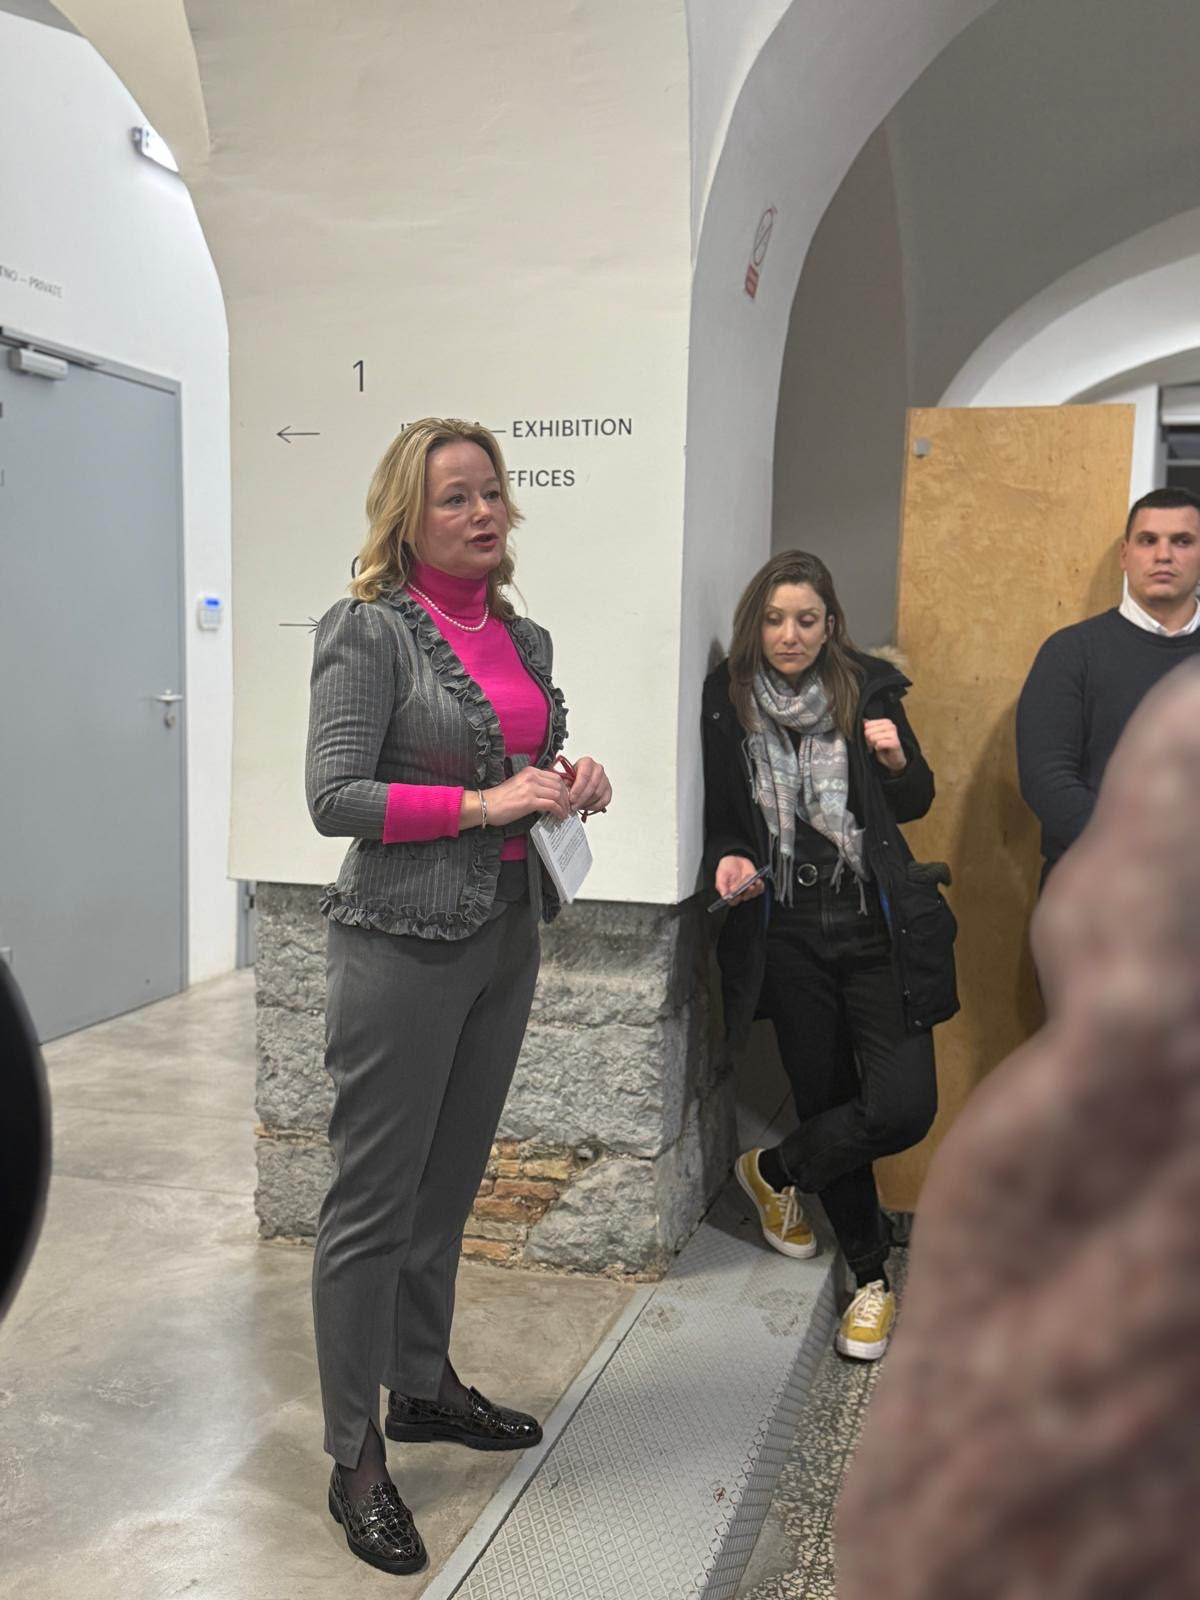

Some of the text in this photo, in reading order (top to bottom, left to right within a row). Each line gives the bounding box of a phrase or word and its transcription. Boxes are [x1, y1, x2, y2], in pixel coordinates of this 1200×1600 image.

[352, 359, 364, 392] 1
[512, 418, 633, 438] EXHIBITION
[507, 469, 576, 487] FFICES
